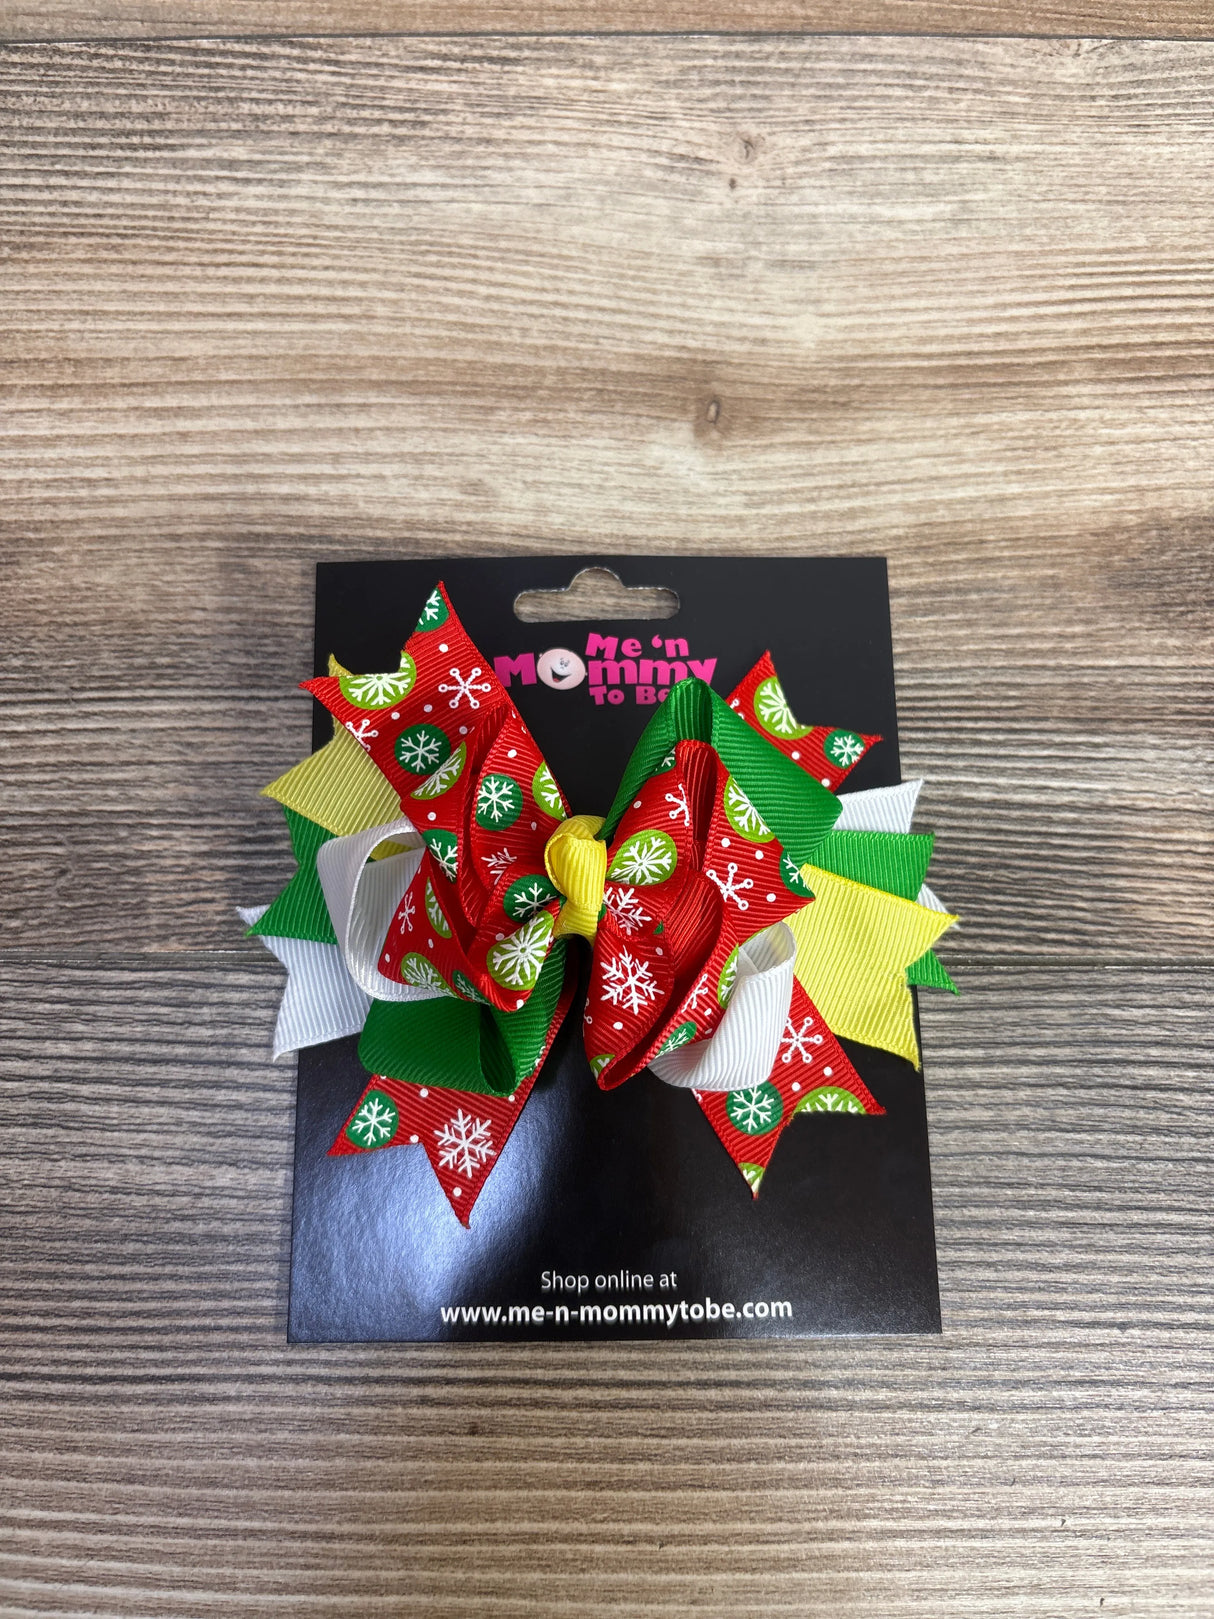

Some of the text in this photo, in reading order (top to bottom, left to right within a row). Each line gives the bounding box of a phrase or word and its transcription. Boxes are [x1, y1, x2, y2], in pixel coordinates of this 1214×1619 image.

[585, 632, 642, 660] Me
[589, 685, 625, 705] To
[541, 1269, 677, 1294] Shop online at
[440, 1298, 793, 1326] www.me-n-mommytobe.com
